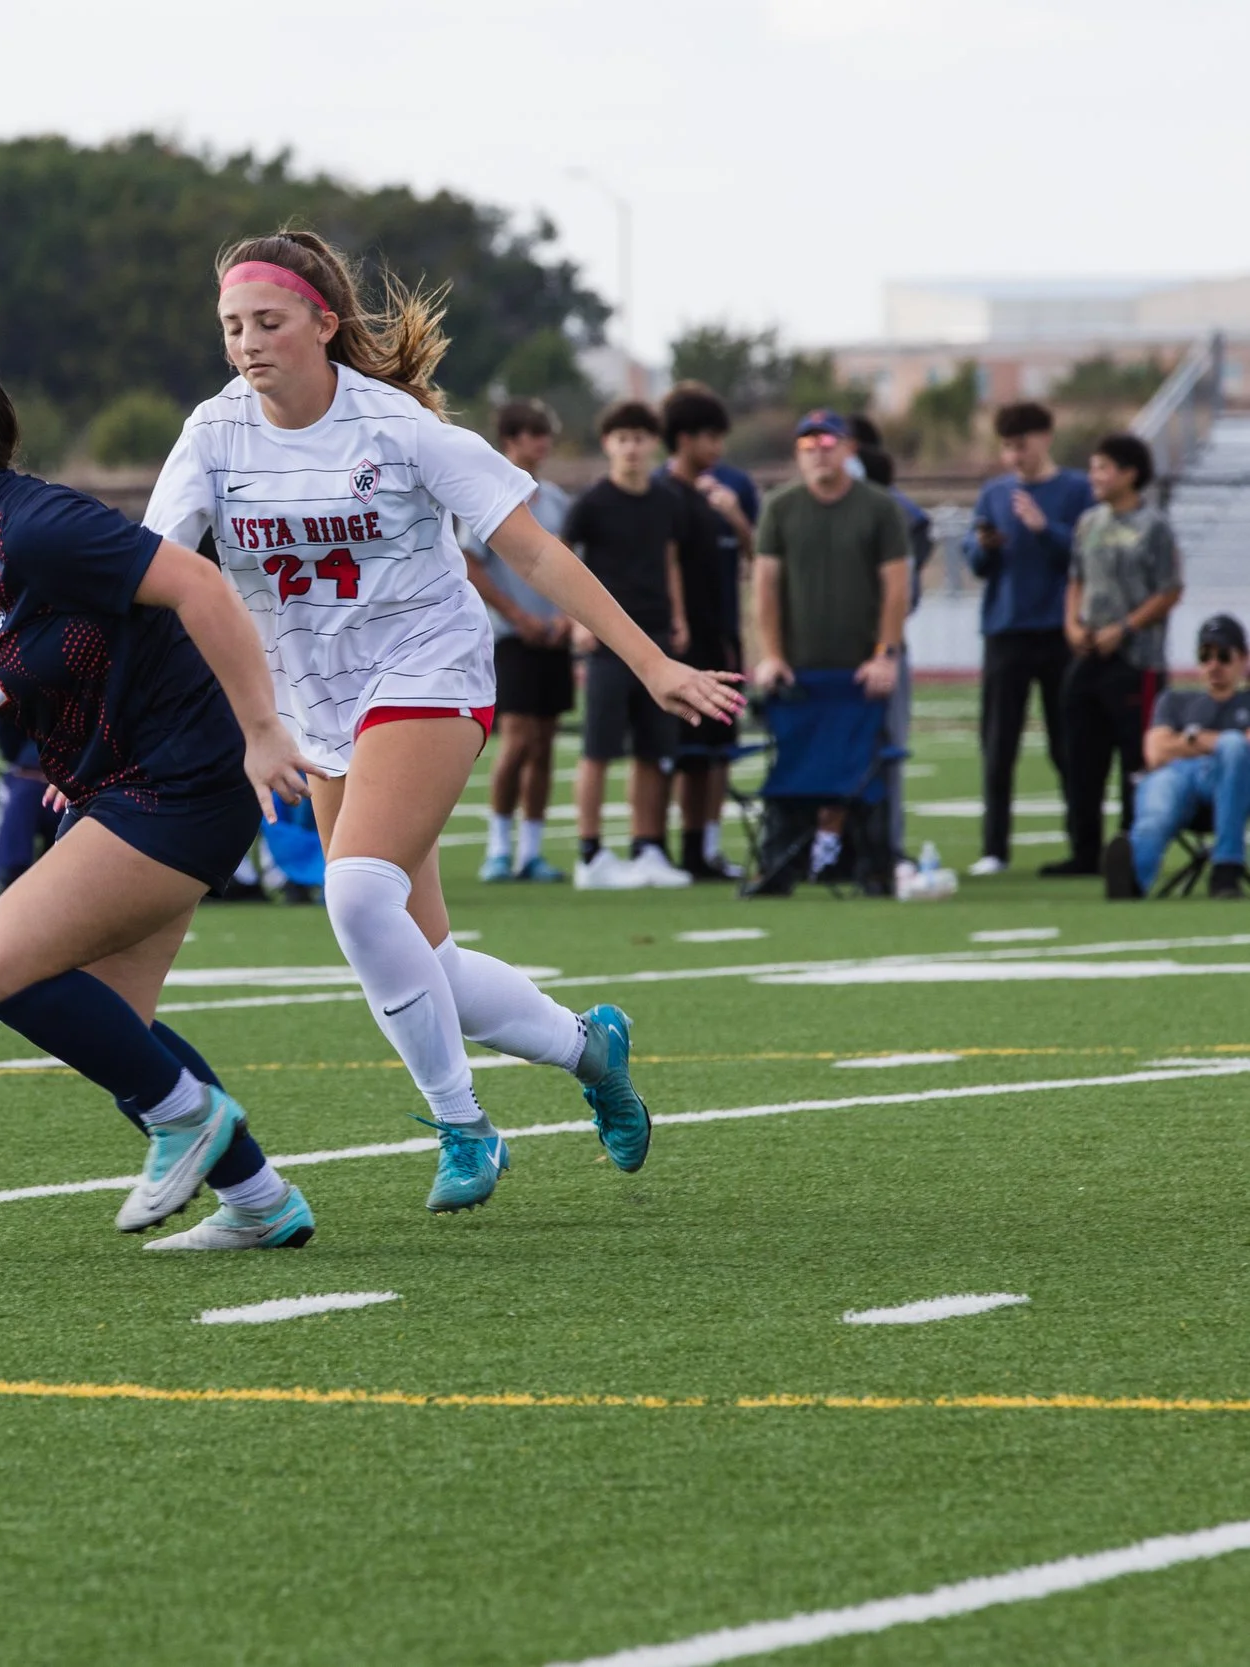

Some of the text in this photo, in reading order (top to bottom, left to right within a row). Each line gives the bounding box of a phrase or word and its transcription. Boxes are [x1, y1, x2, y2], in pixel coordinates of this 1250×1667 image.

[354, 475, 375, 491] VR
[302, 511, 382, 543] RIDGE
[263, 548, 360, 605] 24
